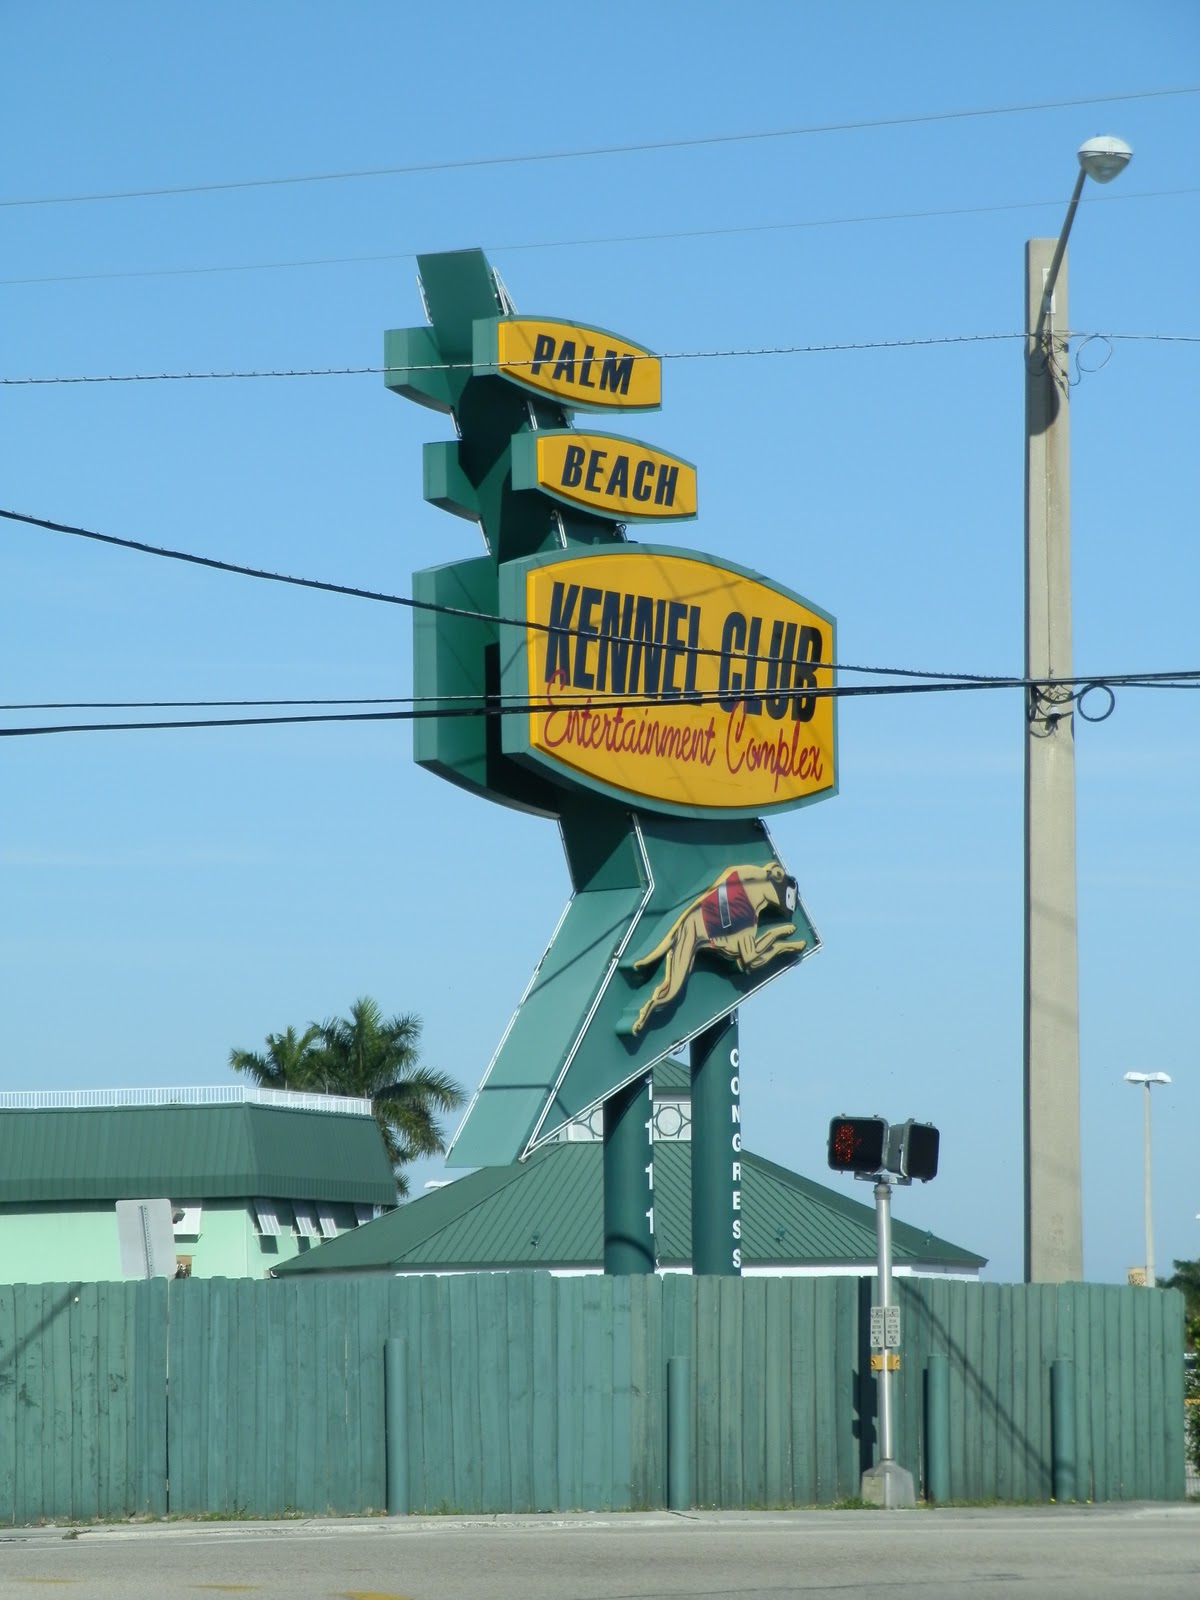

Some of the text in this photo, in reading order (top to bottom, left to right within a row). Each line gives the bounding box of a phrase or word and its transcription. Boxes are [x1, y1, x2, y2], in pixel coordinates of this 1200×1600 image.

[531, 334, 635, 396] PALM
[561, 444, 679, 507] BEACH
[545, 581, 823, 723] KENNEL CLUB
[543, 669, 823, 793] Entertainment Complex
[729, 1048, 741, 1268] CONGRESS
